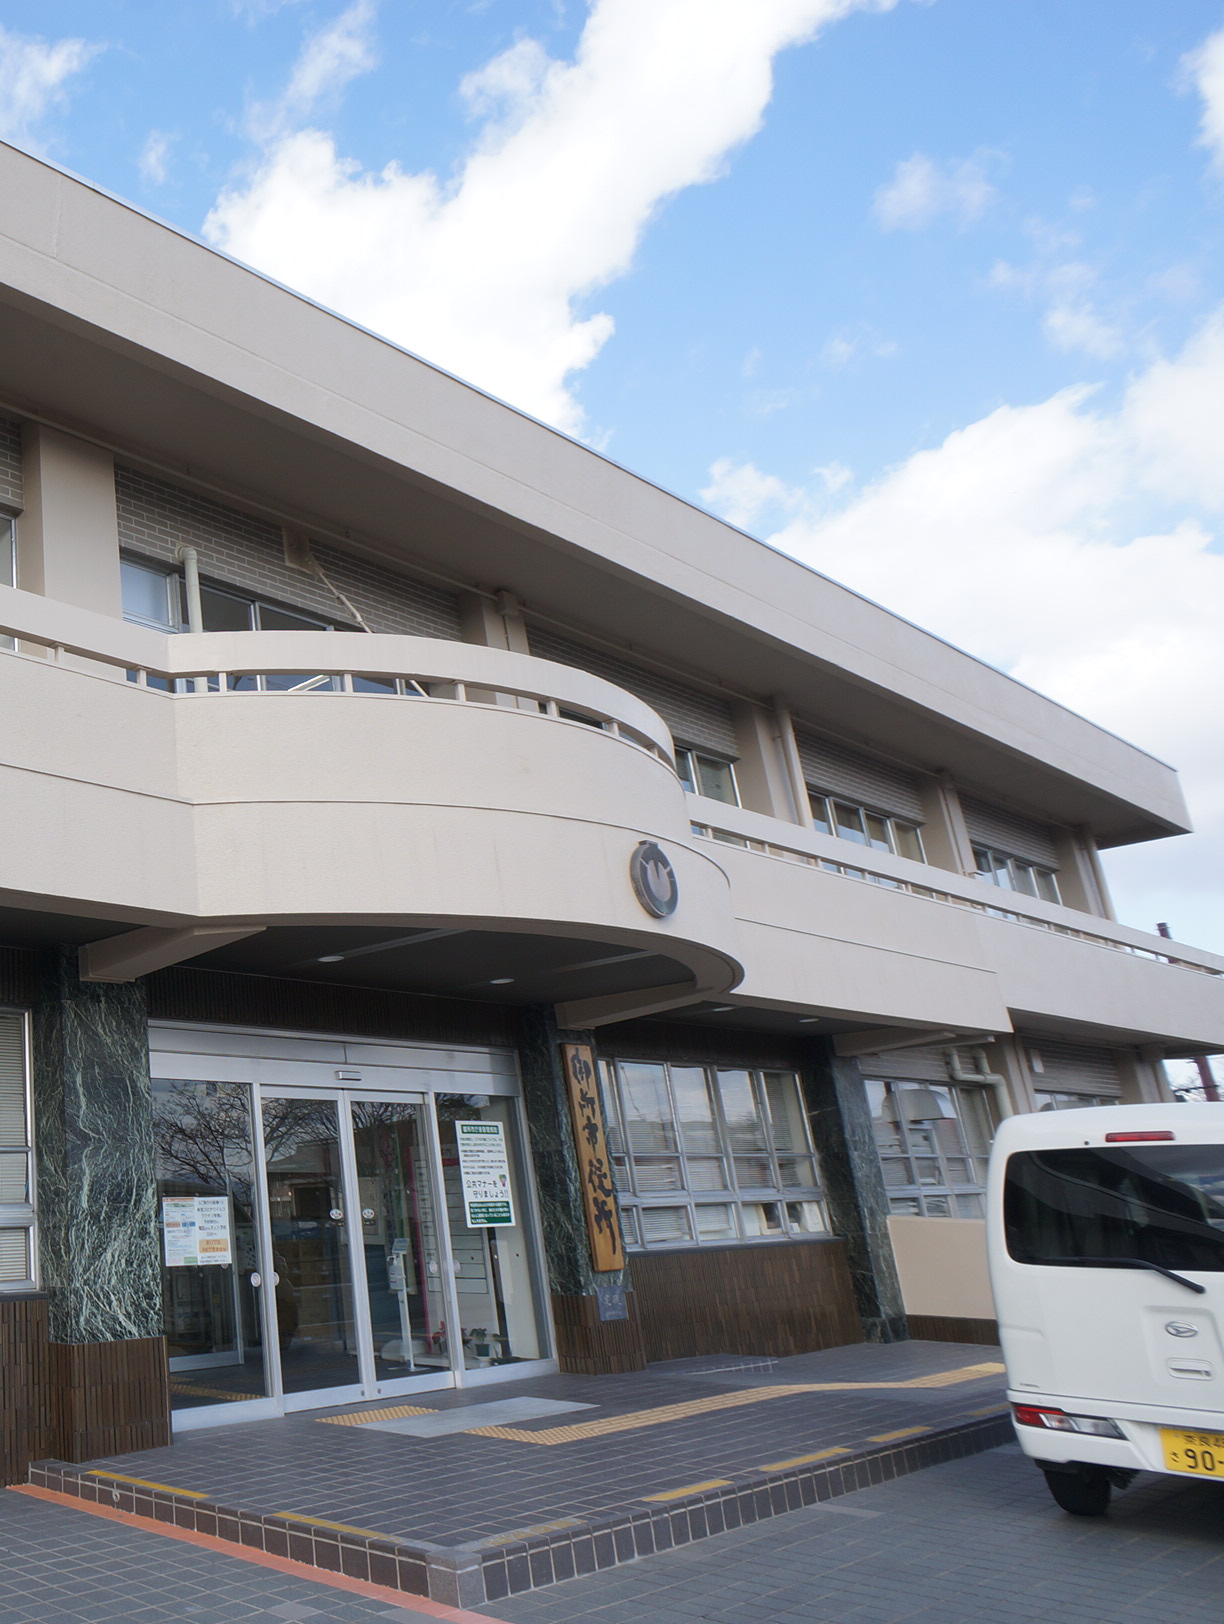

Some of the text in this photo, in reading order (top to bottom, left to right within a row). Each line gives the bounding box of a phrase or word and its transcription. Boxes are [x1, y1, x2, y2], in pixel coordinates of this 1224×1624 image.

[466, 1179, 498, 1189] 公共マナーを
[571, 1046, 617, 1255] 御所市役所
